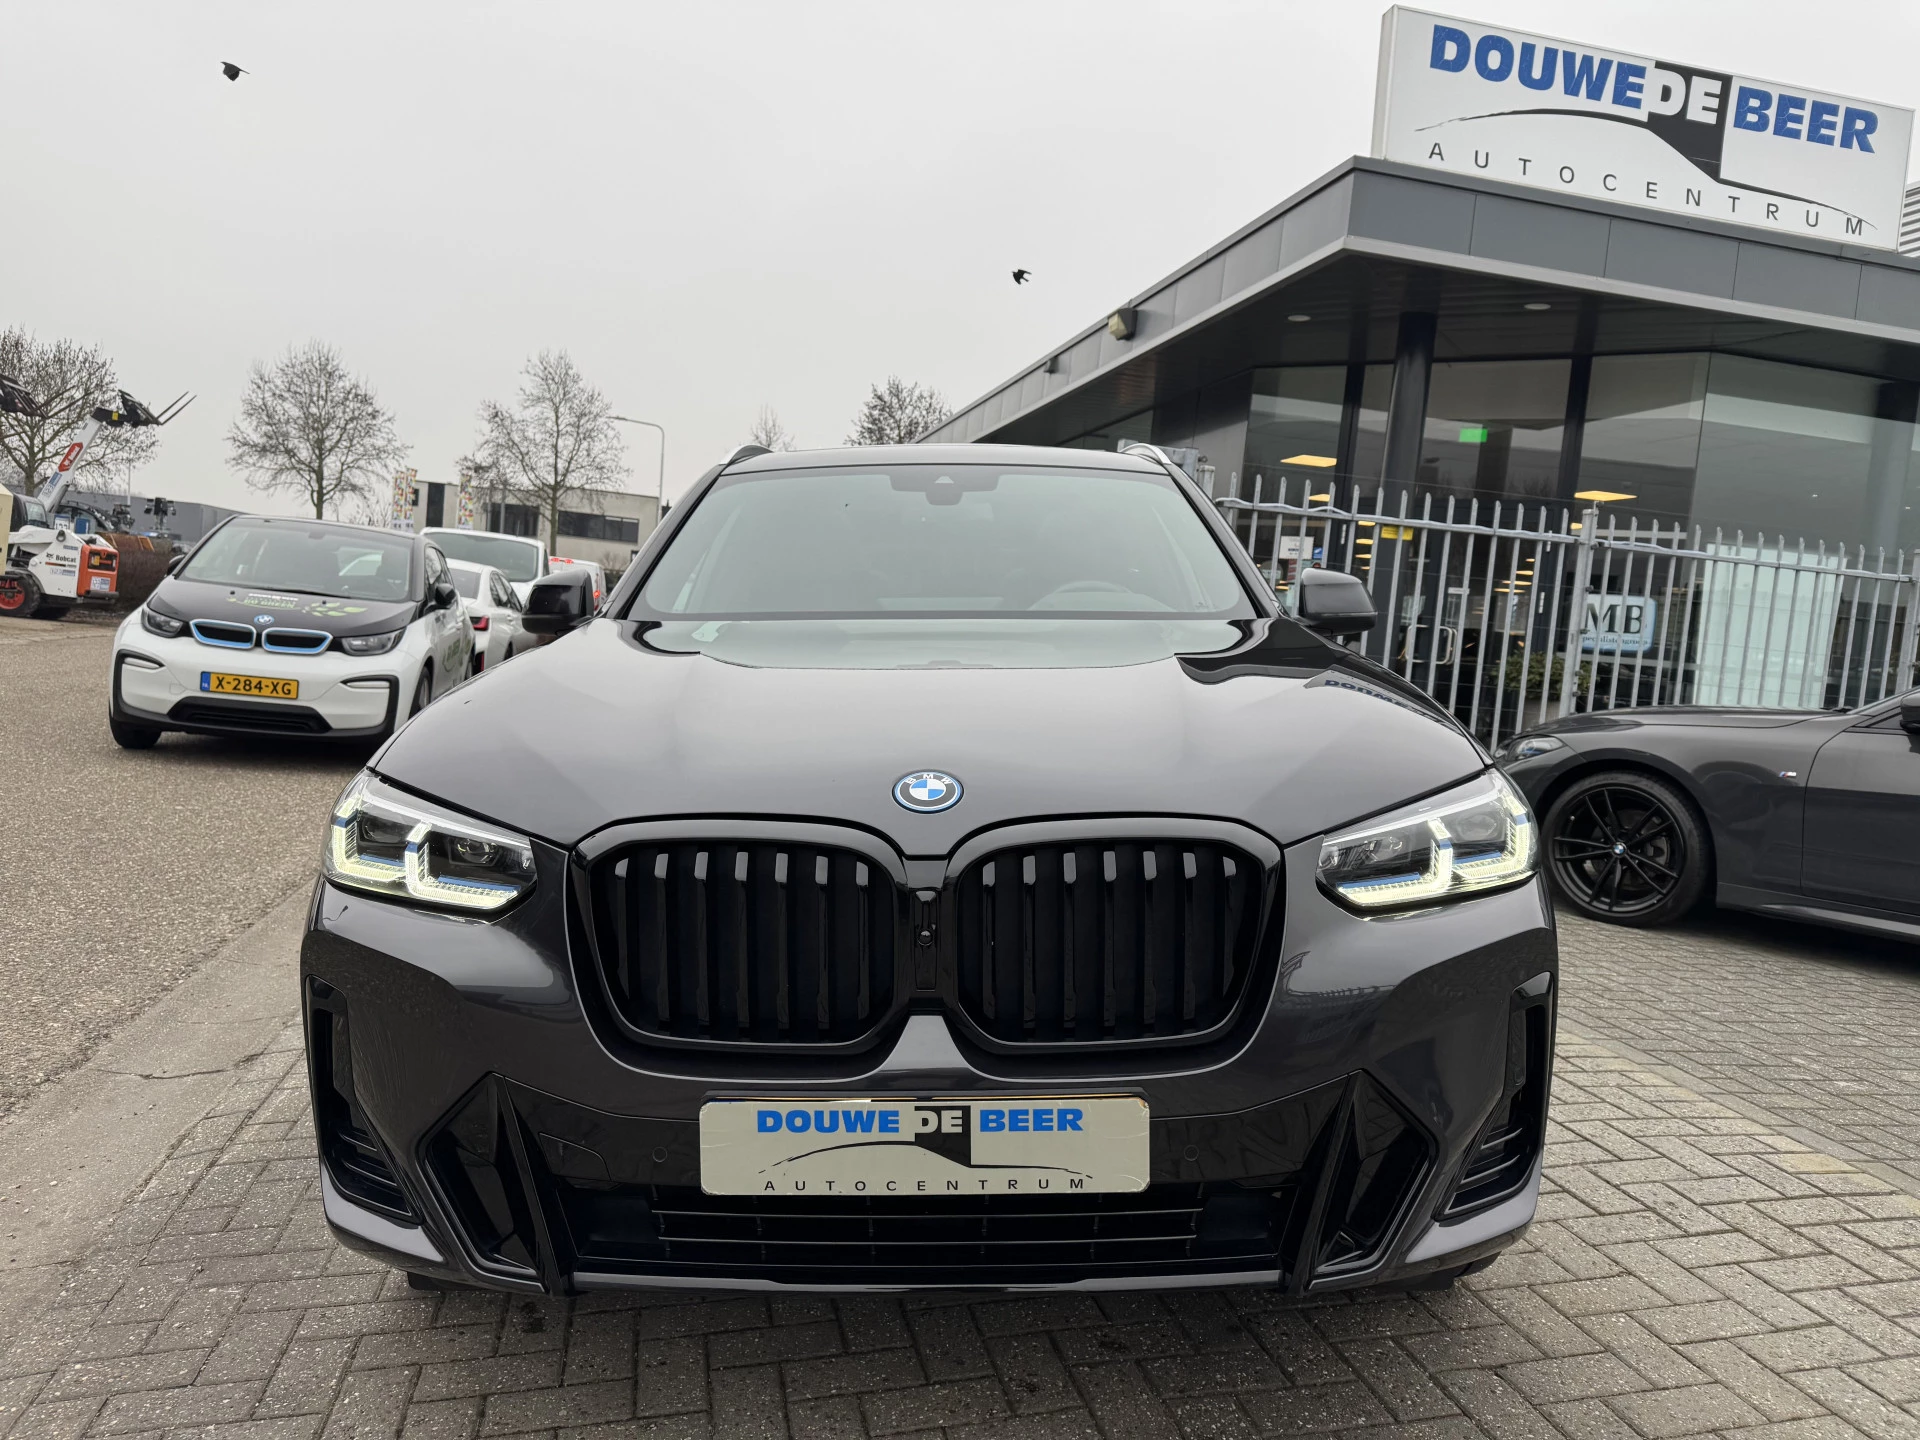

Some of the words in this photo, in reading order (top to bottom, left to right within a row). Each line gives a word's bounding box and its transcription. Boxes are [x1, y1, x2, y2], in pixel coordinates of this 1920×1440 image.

[1430, 24, 1648, 109] DOUWE
[1650, 68, 1723, 125] DE
[1733, 86, 1879, 154] BEER
[1429, 142, 1863, 237] AUTOCENTRUM
[55, 554, 77, 563] Bobcat
[1585, 603, 1644, 634] MB
[215, 676, 292, 695] X-284-XG
[904, 773, 954, 785] BMW
[757, 1109, 900, 1134] DOUWE
[914, 1109, 963, 1134] DE
[980, 1108, 1084, 1133] BEER
[764, 1178, 1084, 1192] AUTOCENTRUM
